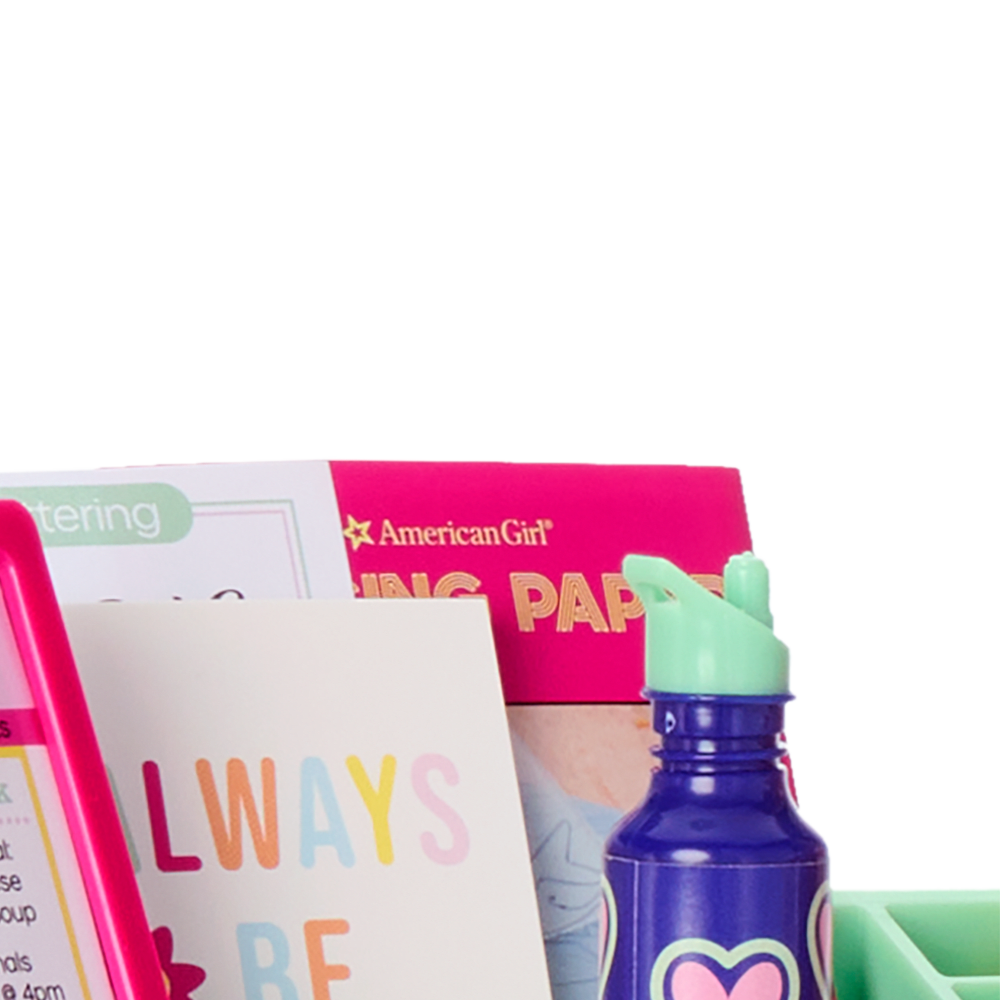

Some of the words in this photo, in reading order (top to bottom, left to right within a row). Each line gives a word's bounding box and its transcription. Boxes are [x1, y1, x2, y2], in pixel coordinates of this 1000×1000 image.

[22, 499, 160, 538] tering
[379, 519, 500, 546] American
[510, 572, 724, 633] PAP
[106, 752, 471, 874] LWAYS
